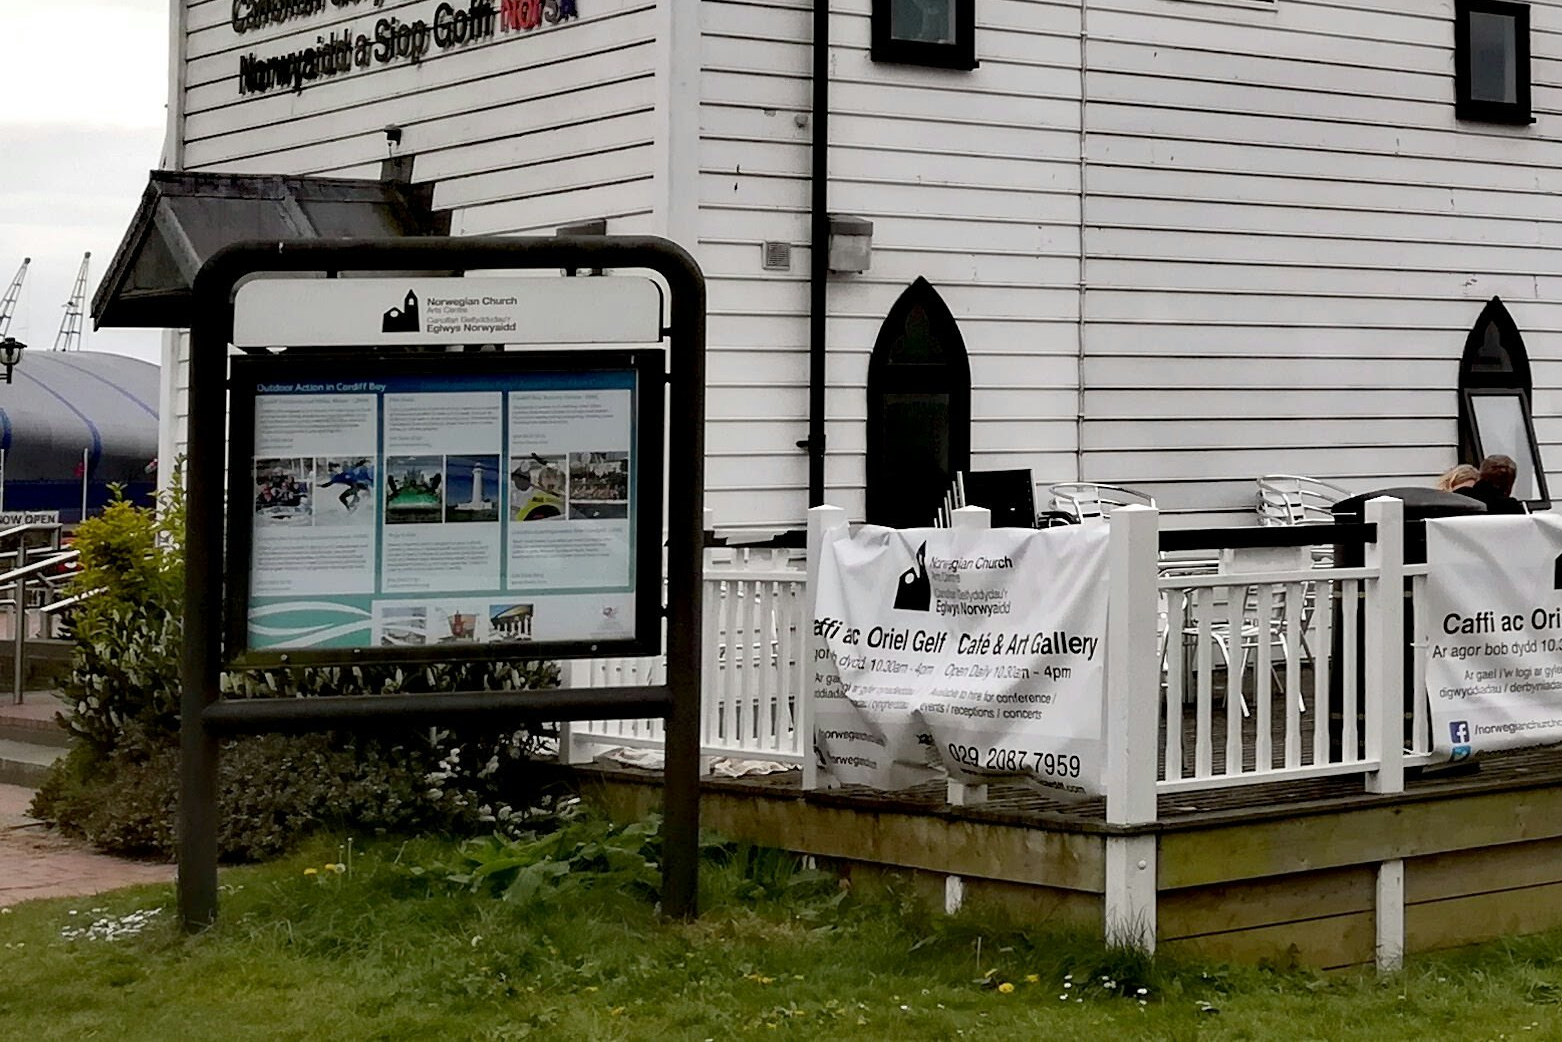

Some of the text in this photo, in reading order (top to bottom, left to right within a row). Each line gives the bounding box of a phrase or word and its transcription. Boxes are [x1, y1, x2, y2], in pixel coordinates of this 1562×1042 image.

[374, 17, 431, 67] Siop
[427, 297, 517, 308] Norwegian Church
[257, 382, 386, 392] Outdoor Action in Cardiff Bay
[0, 514, 55, 525] OW OPEN
[975, 555, 1013, 570] Church
[1443, 611, 1495, 635] Caffi
[1501, 614, 1524, 632] ac
[842, 627, 860, 646] ac
[867, 626, 909, 651] Oriel
[912, 630, 947, 654] Gelf
[957, 632, 991, 655] Café
[993, 632, 1004, 655] &
[1005, 633, 1029, 655] Art
[1030, 631, 1098, 660] Gallery
[1432, 645, 1448, 658] Ar
[1451, 645, 1482, 660] agor
[1484, 642, 1509, 656] bob
[1511, 640, 1537, 657] dydd
[944, 663, 968, 677] Open
[969, 663, 992, 680] Daily
[1044, 666, 1072, 681] 4pm
[1464, 670, 1475, 680] Ar
[1476, 669, 1497, 681] gael
[996, 692, 1051, 705] conference
[948, 743, 1081, 779] 029 2087 7959
